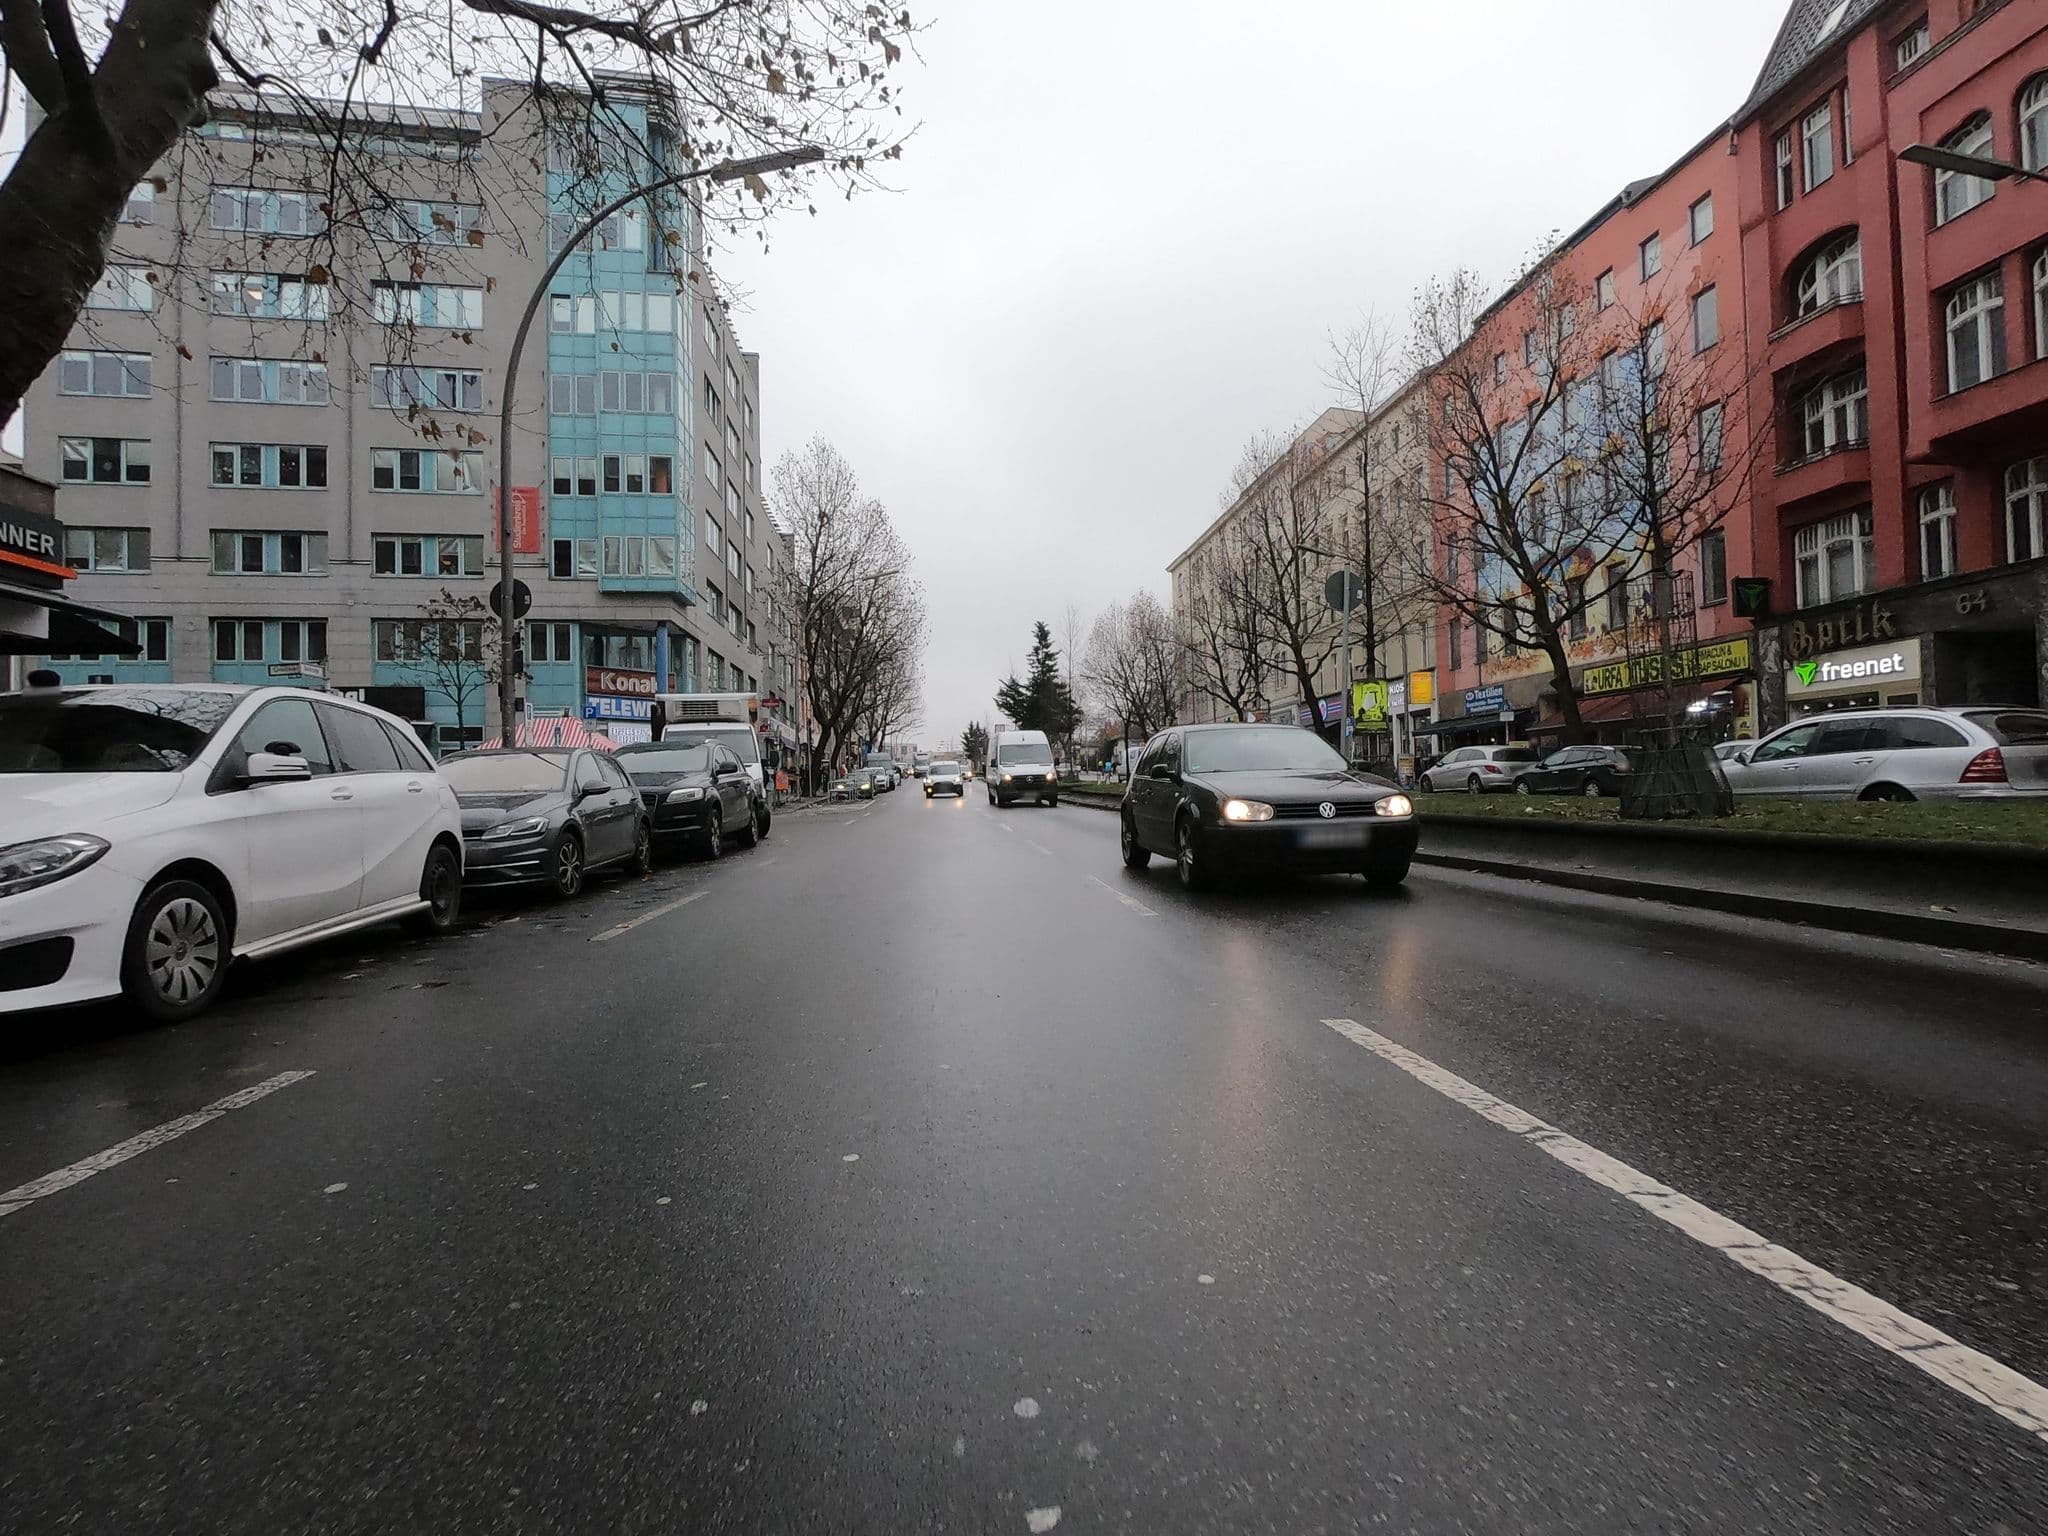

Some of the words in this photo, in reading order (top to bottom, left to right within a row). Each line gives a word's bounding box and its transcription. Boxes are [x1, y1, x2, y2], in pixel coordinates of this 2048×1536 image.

[1598, 667, 1624, 690] URFA
[1821, 653, 1905, 681] freenet
[585, 707, 594, 718] P
